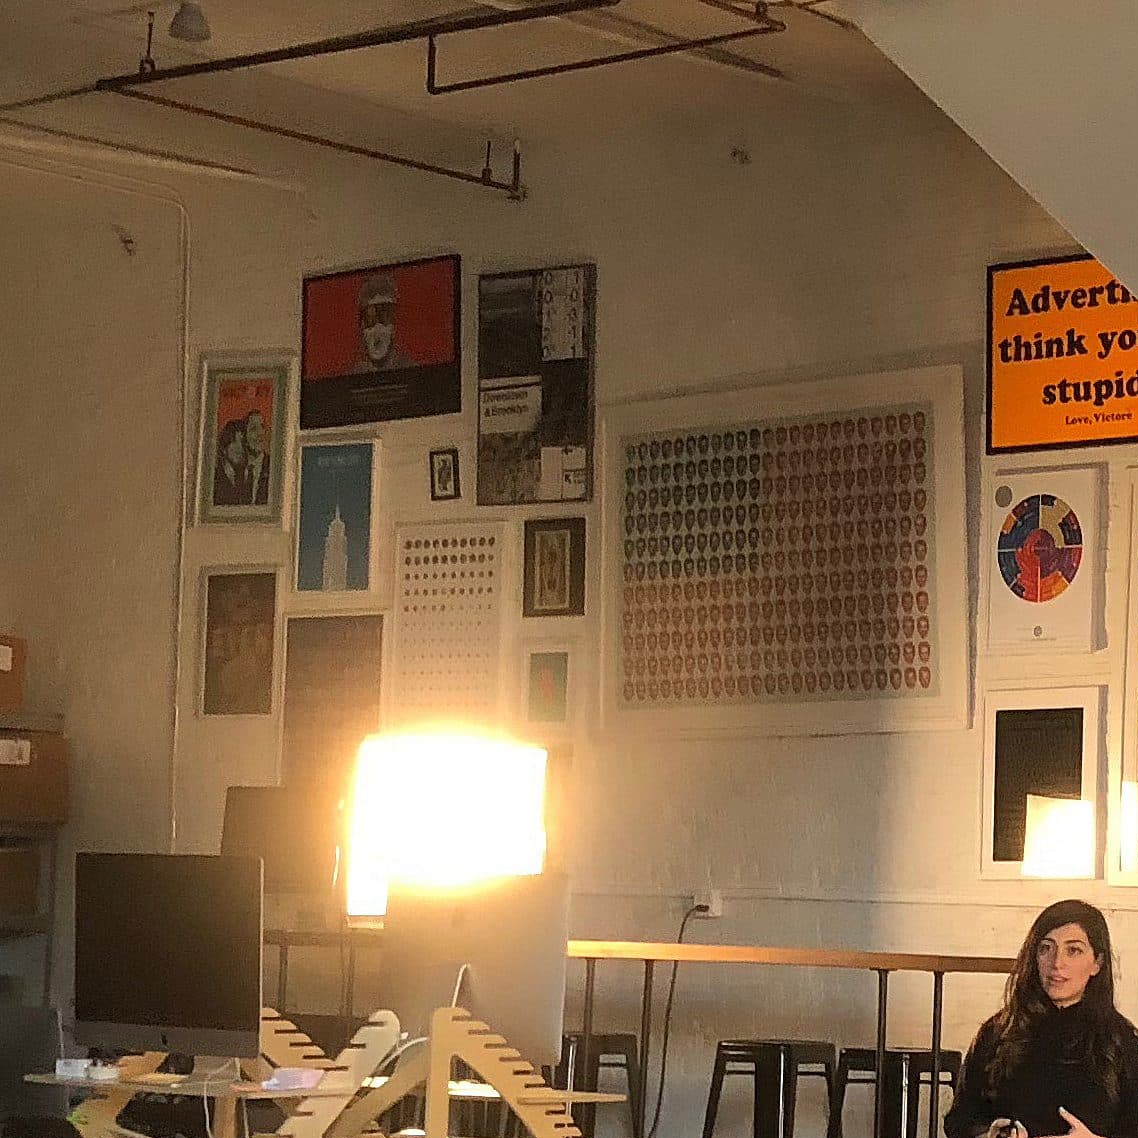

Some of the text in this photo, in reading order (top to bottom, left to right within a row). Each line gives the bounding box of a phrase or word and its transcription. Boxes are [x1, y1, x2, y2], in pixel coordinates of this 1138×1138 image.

[1005, 279, 1138, 317] Adverti
[998, 328, 1088, 363] think
[1065, 412, 1133, 425] Love, Victore
